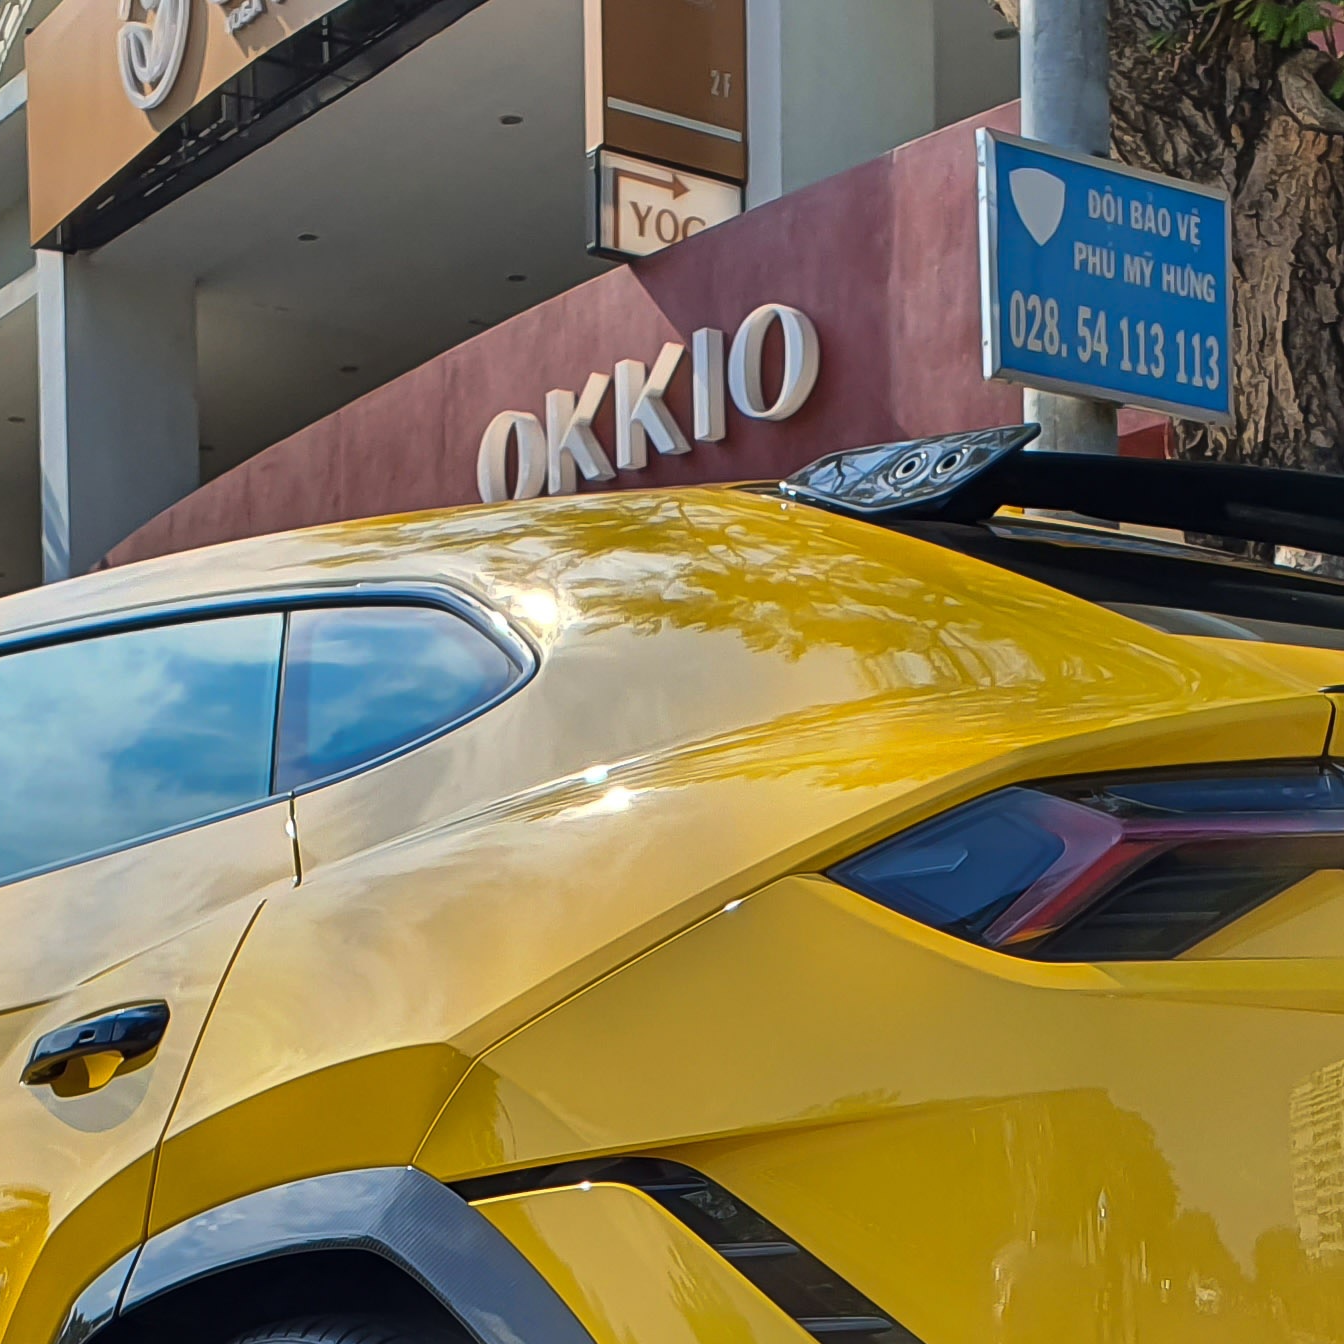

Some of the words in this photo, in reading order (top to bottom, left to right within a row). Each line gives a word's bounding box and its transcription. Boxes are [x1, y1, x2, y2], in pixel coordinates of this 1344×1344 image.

[1130, 192, 1171, 237] BẢO
[1176, 208, 1201, 252] VỆ
[1074, 241, 1115, 279] PHÚ
[1124, 251, 1154, 288] MỸ
[1162, 263, 1216, 303] HƯNG
[1010, 290, 1067, 358] 028.
[1077, 305, 1109, 367] 54
[1119, 316, 1165, 379] 113
[1176, 329, 1220, 391] 113
[477, 303, 820, 503] OKKIO
